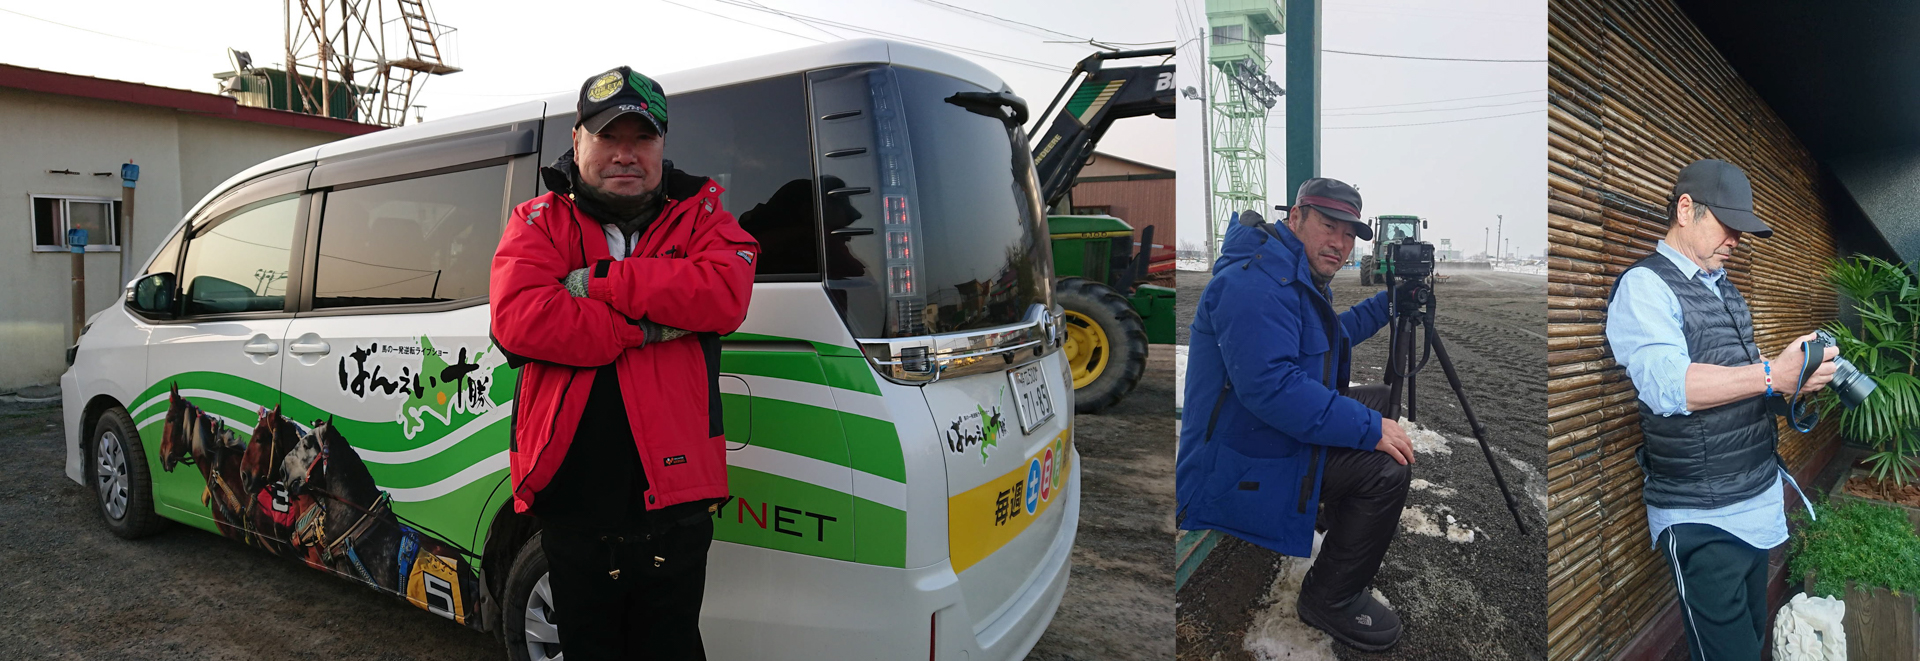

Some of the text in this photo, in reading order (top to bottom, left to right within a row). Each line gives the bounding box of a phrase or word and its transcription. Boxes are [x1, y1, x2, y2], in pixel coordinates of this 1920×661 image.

[1041, 134, 1062, 157] DEERE
[382, 344, 449, 357] 馬の一発逆転ライブショー
[339, 342, 494, 409] ばんえい十勝
[995, 480, 1024, 526] 毎週
[424, 571, 454, 620] 5
